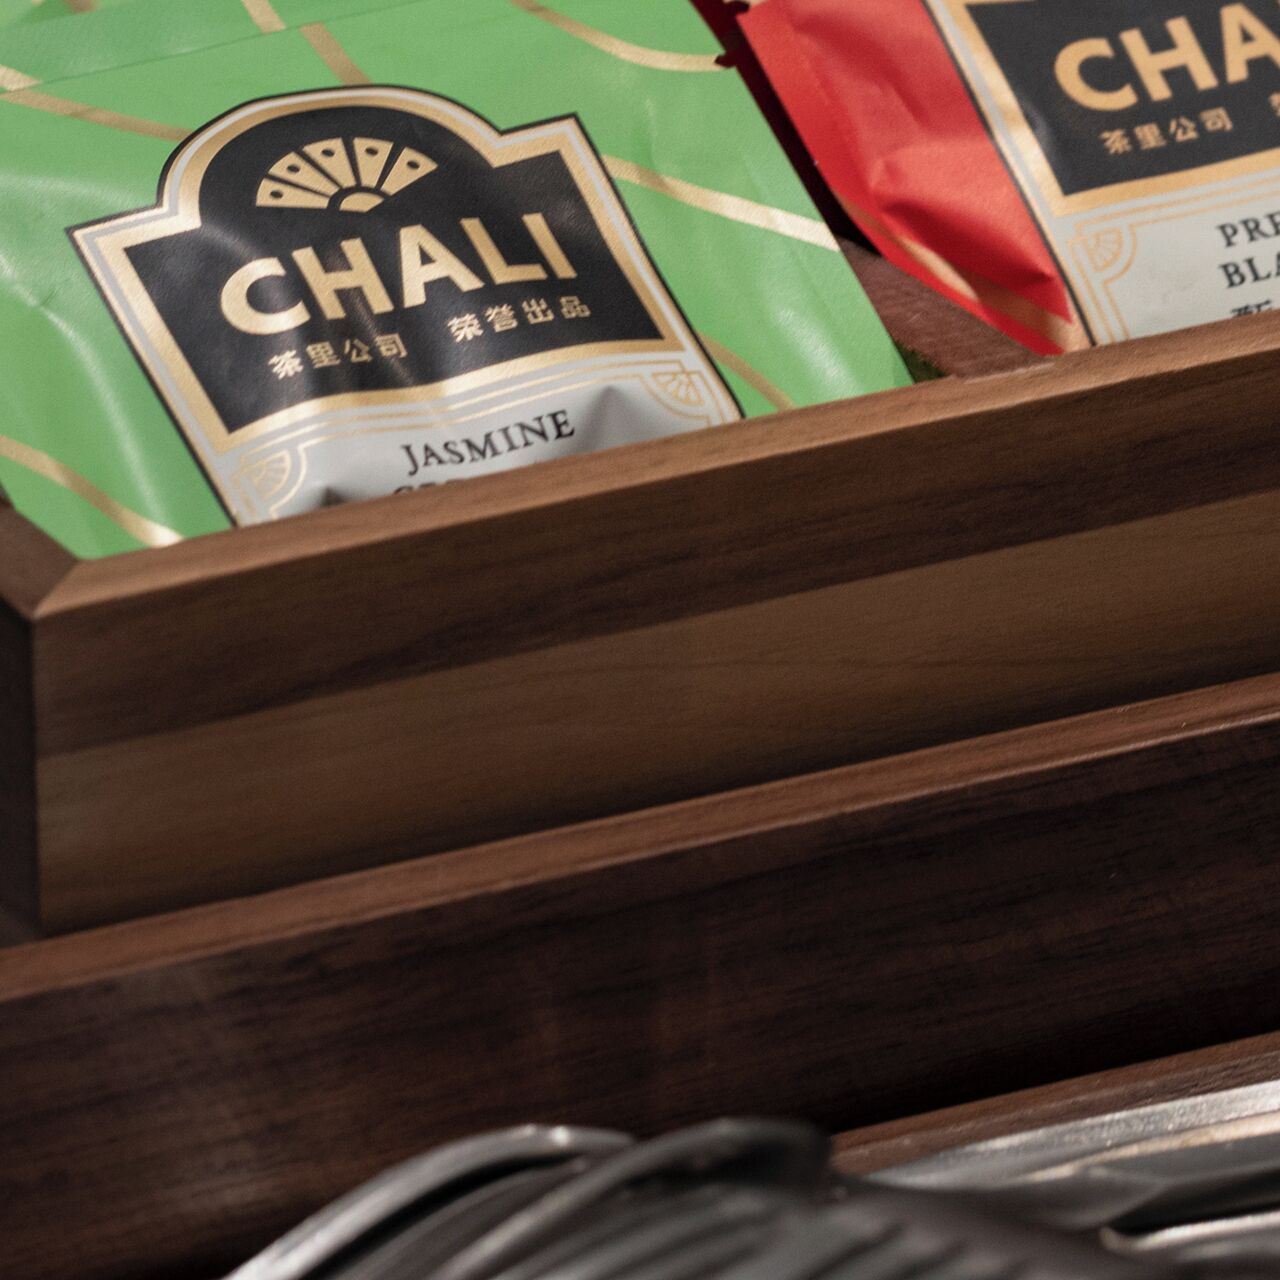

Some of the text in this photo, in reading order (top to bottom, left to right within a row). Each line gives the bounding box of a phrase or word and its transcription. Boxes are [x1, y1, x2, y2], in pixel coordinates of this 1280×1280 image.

[1098, 106, 1233, 156] 茶里公司
[219, 212, 578, 336] CHALI
[267, 295, 592, 380] 茶里公司 荣誉出品
[400, 409, 576, 477] JASMINE
